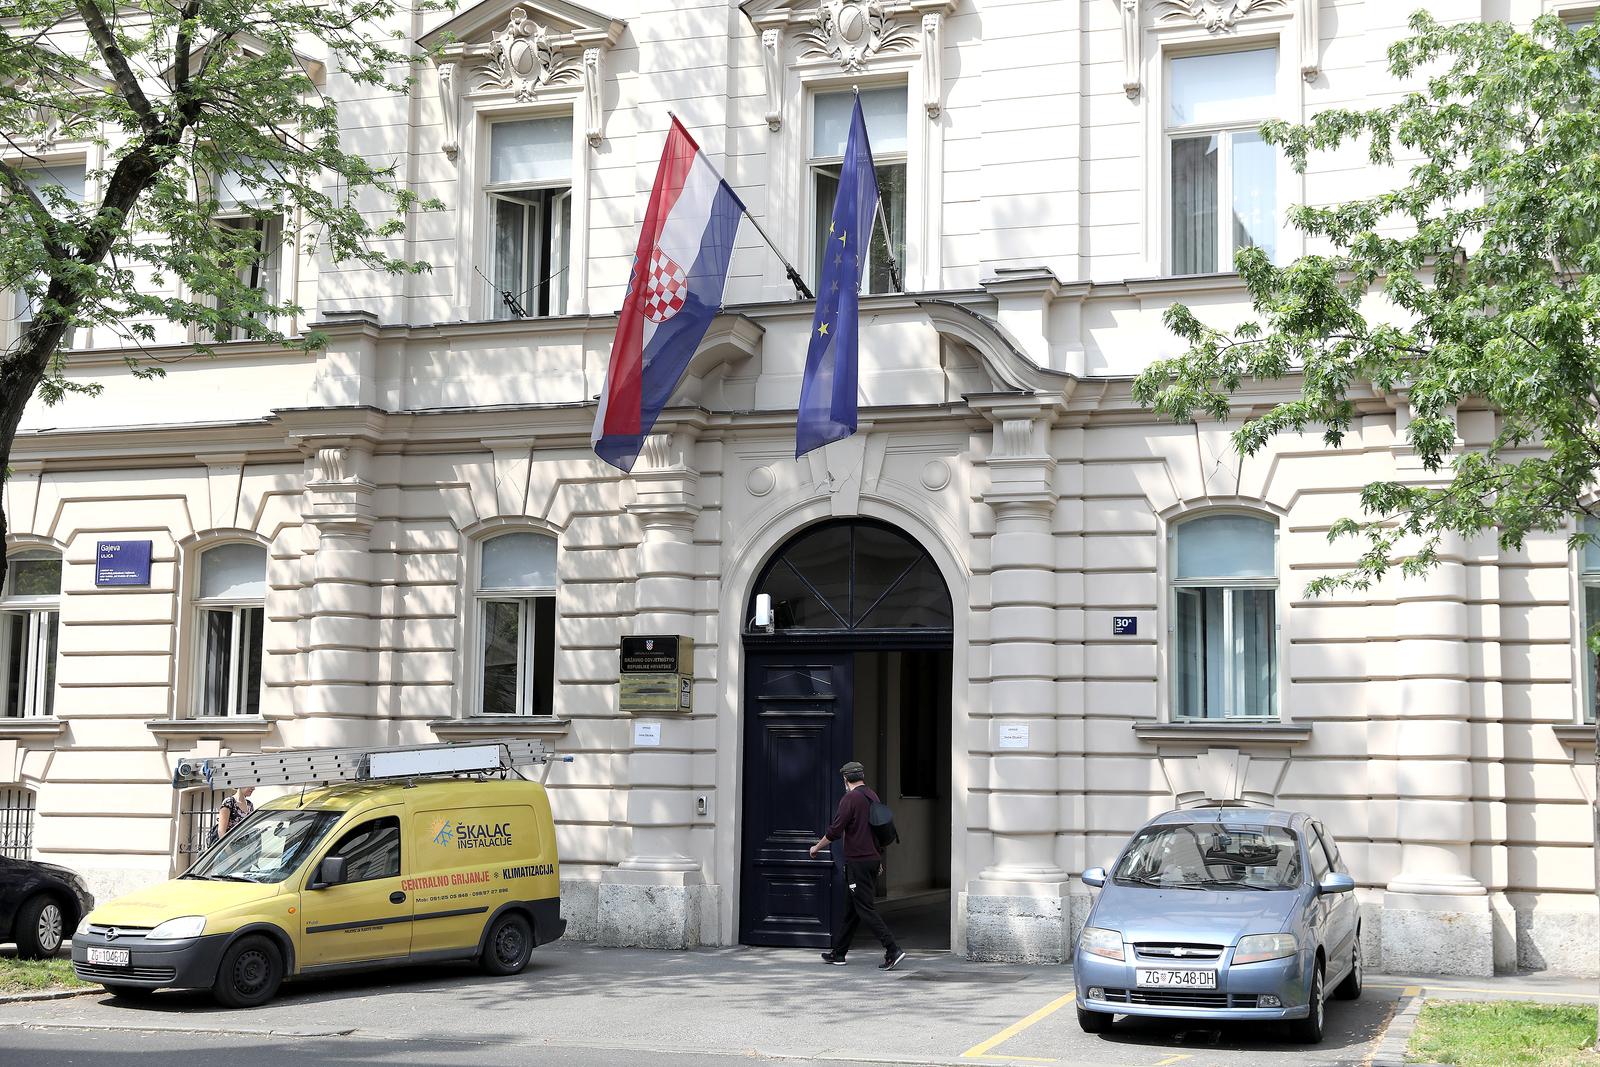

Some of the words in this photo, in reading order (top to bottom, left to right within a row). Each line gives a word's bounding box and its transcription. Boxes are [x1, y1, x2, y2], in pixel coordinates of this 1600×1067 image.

[101, 544, 120, 552] Gajeva
[456, 822, 512, 840] ŠKALAC
[458, 837, 512, 849] INSTALACIJE
[401, 876, 449, 891] CENTRALNO
[451, 870, 490, 886] GRIJANJE
[502, 864, 554, 879] KLIMATIZACIJA
[91, 950, 98, 960] ZG
[1146, 971, 1160, 984] ZG
[1168, 972, 1214, 984] 7548-DH
